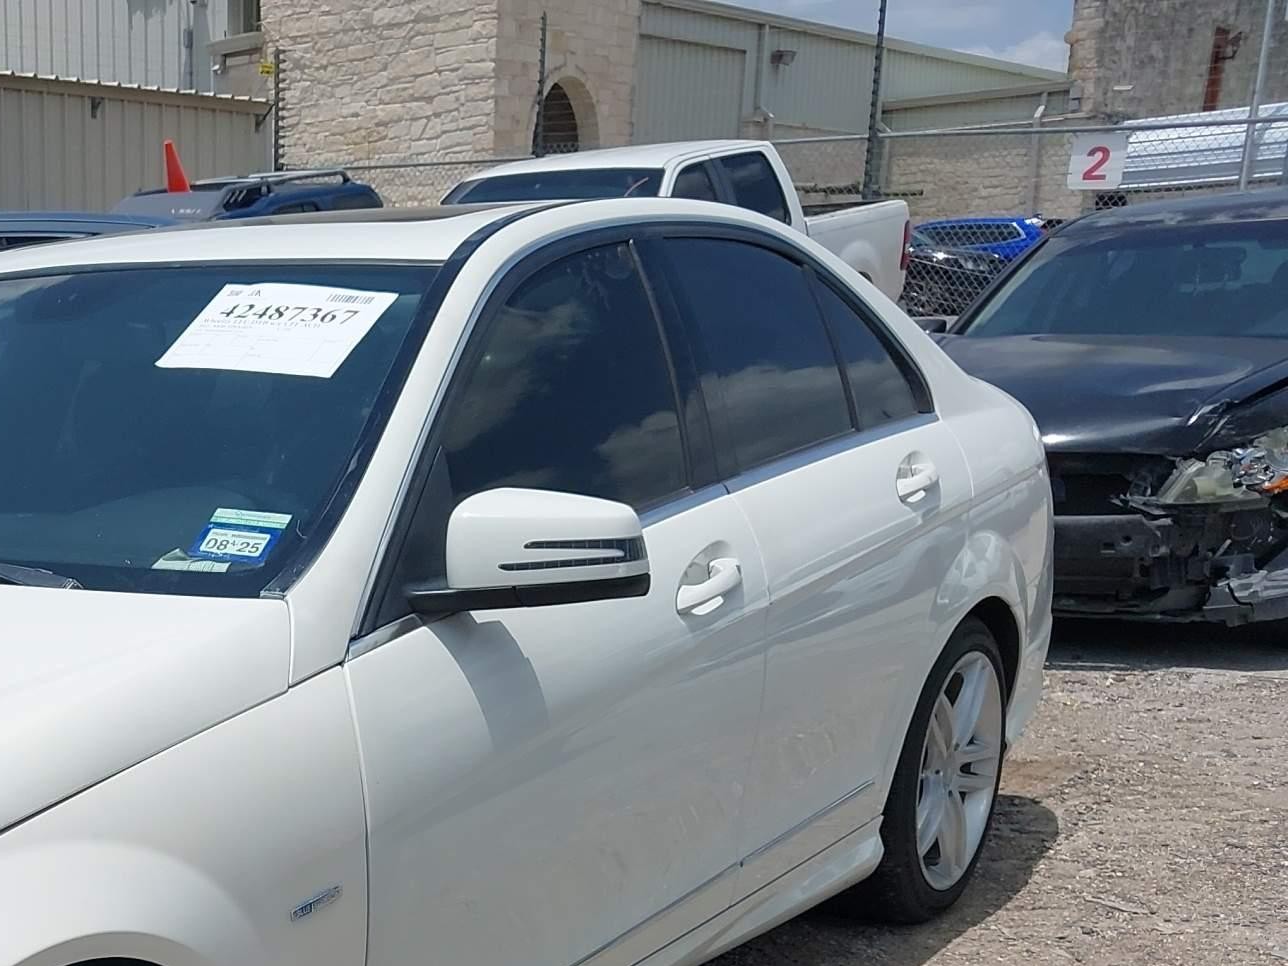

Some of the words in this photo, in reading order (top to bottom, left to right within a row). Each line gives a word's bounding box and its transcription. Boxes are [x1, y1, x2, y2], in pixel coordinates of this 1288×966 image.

[1082, 146, 1111, 181] 2
[220, 303, 360, 325] 42487367
[205, 537, 229, 551] 08
[236, 541, 263, 554] 25
